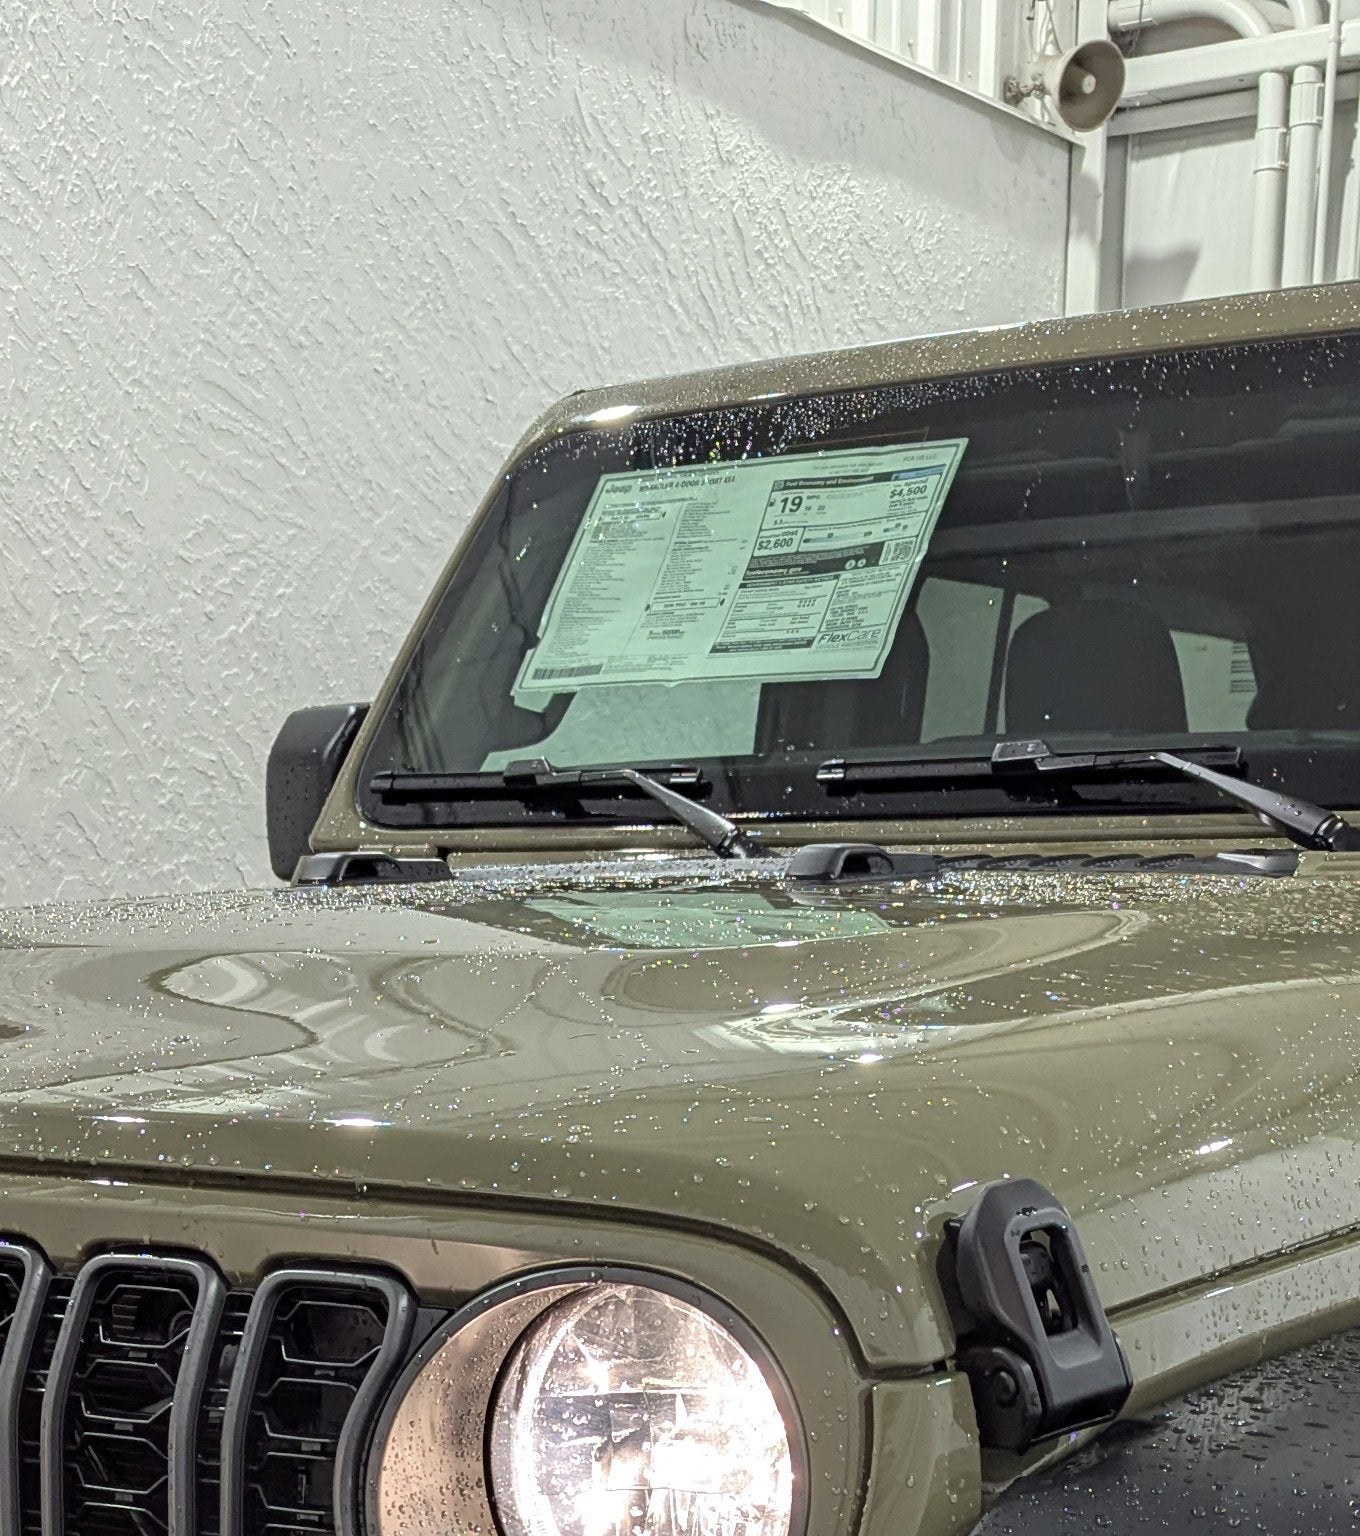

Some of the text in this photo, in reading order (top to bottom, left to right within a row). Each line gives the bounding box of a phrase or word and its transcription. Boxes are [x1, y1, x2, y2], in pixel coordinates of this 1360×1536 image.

[888, 485, 928, 499] $4,500
[779, 495, 804, 514] 19
[756, 537, 794, 551] $2,600
[817, 628, 882, 644] FlexCare
